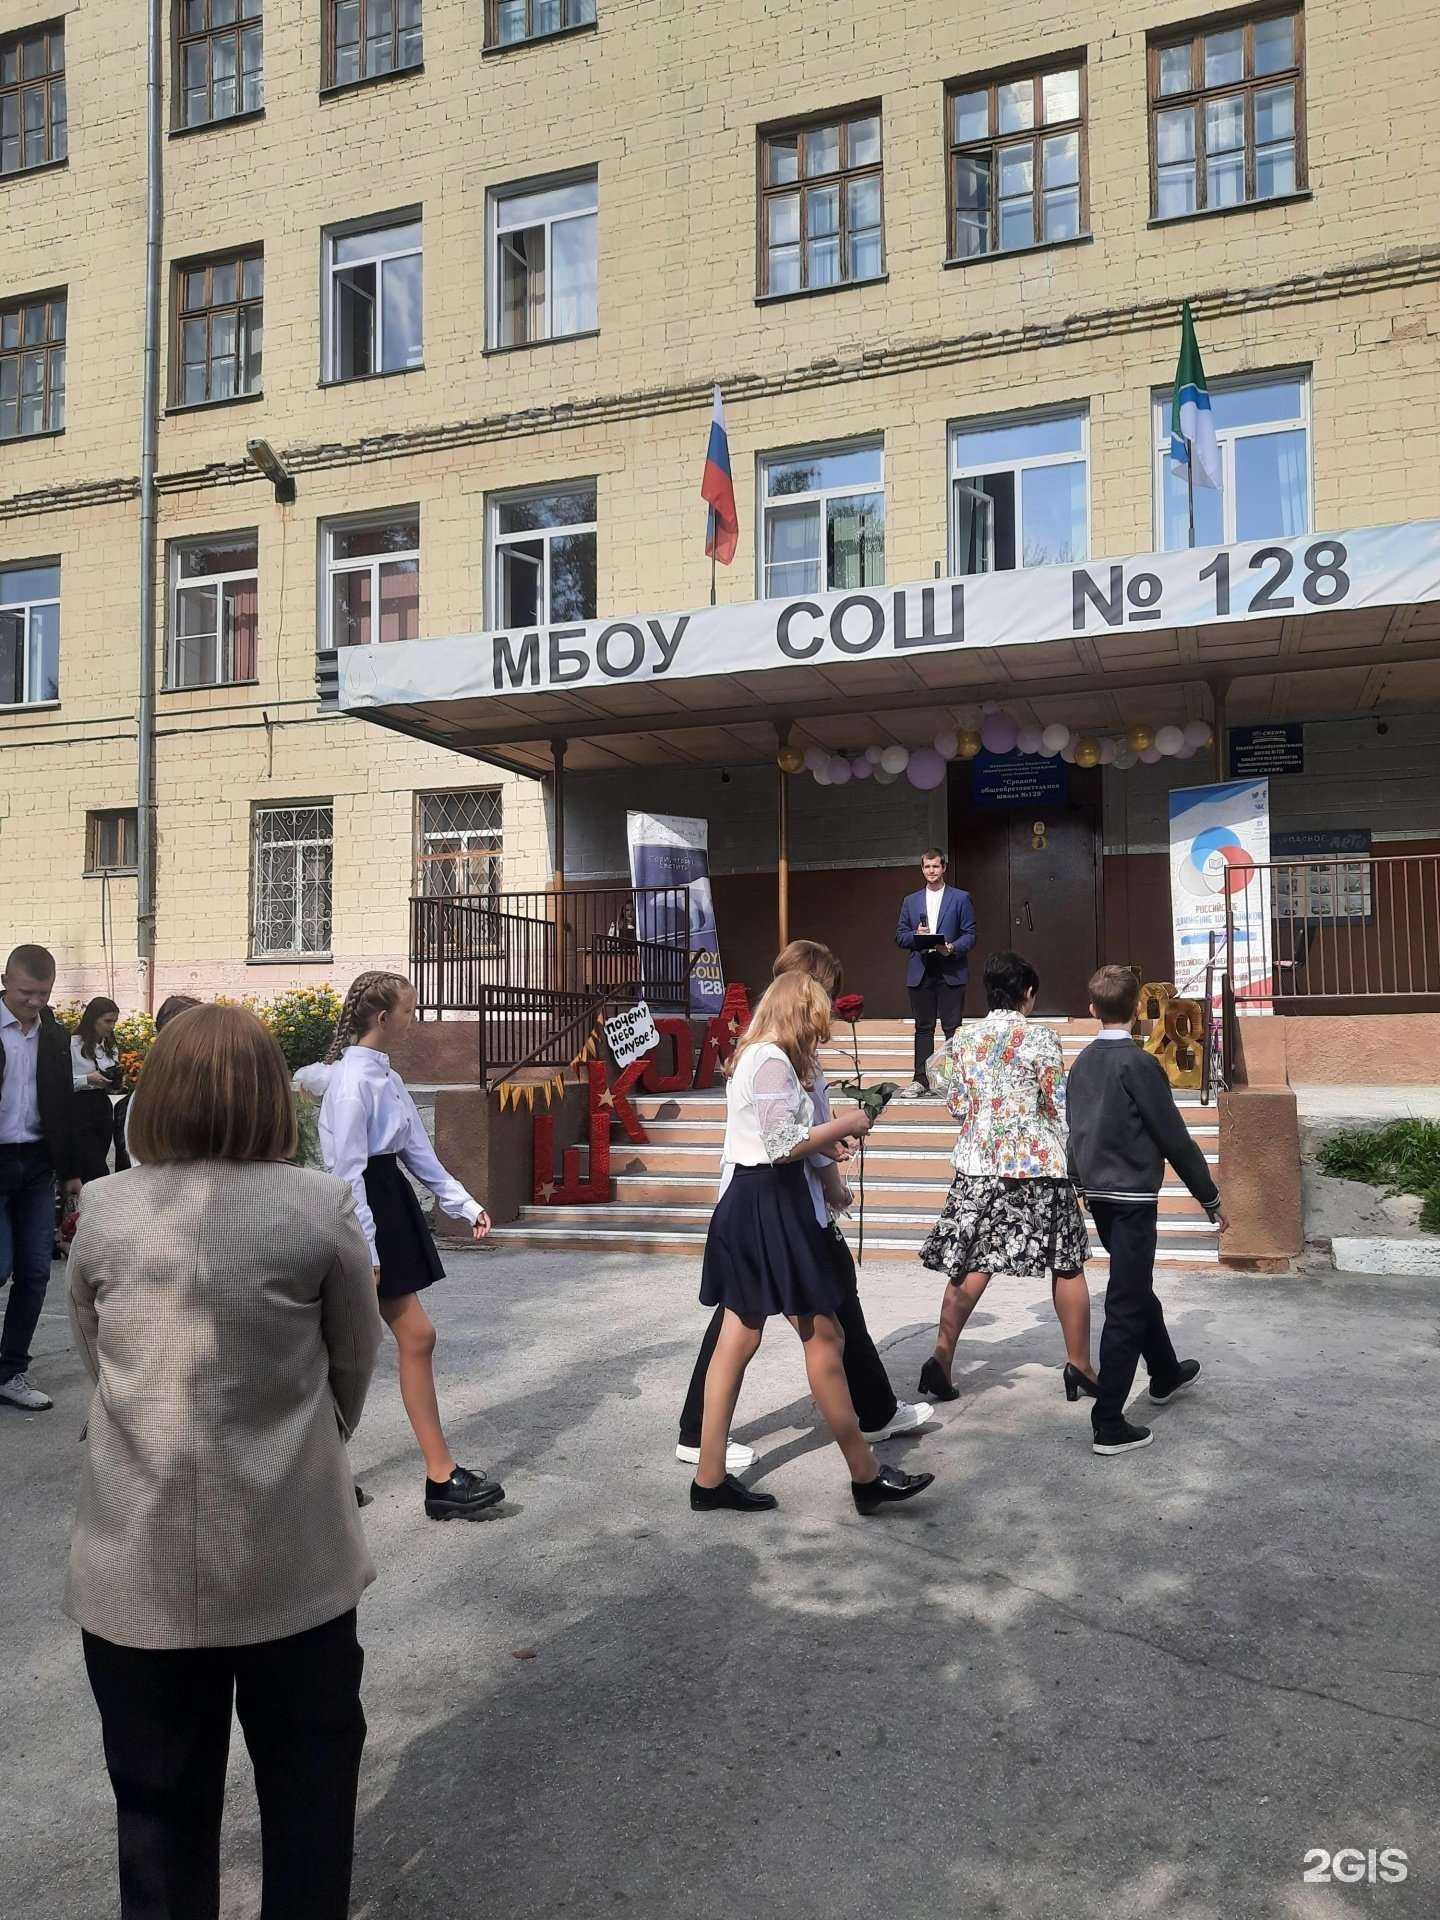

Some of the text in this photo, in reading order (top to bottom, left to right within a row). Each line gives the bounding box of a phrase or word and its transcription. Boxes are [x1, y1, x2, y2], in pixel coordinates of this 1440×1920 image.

[492, 540, 1351, 690] МБОУ СОШ № 128
[698, 980, 722, 995] 128
